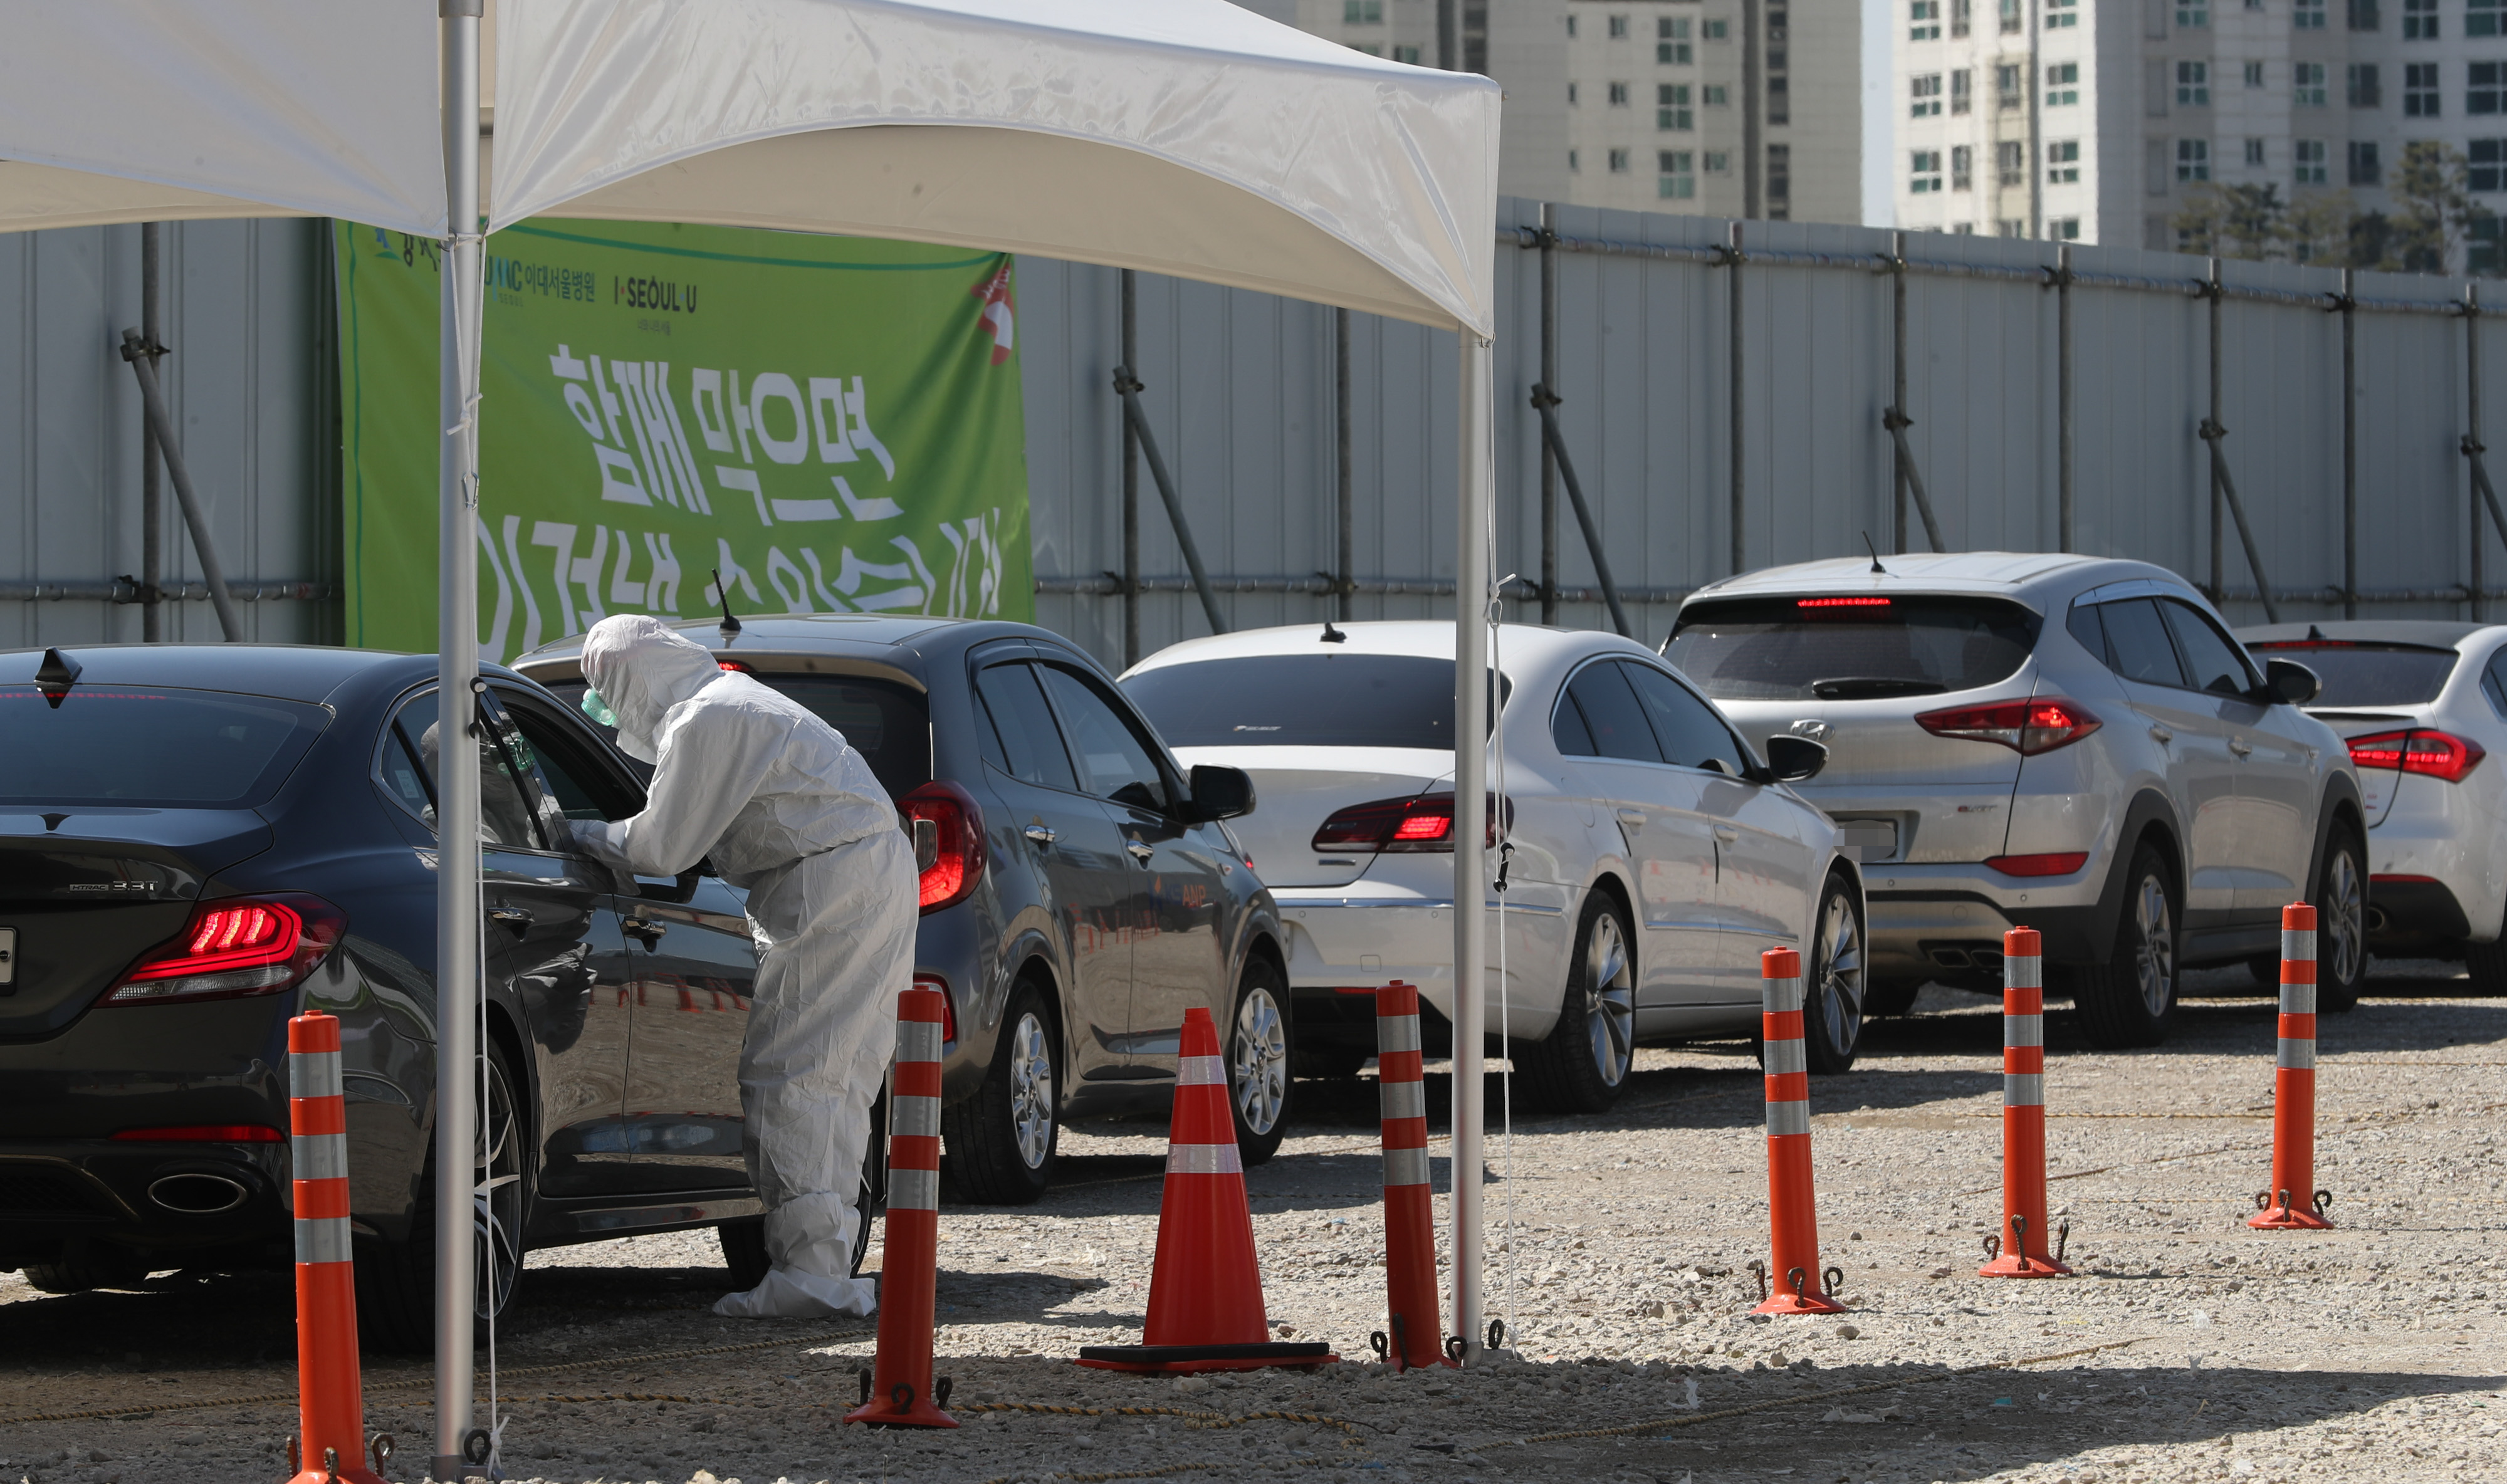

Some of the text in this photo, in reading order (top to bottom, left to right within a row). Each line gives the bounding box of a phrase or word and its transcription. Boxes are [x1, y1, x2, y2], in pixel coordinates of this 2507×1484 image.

[525, 263, 595, 303] 이대서울병원
[549, 343, 906, 527] 함께 막으면
[113, 880, 158, 891] 3.3T
